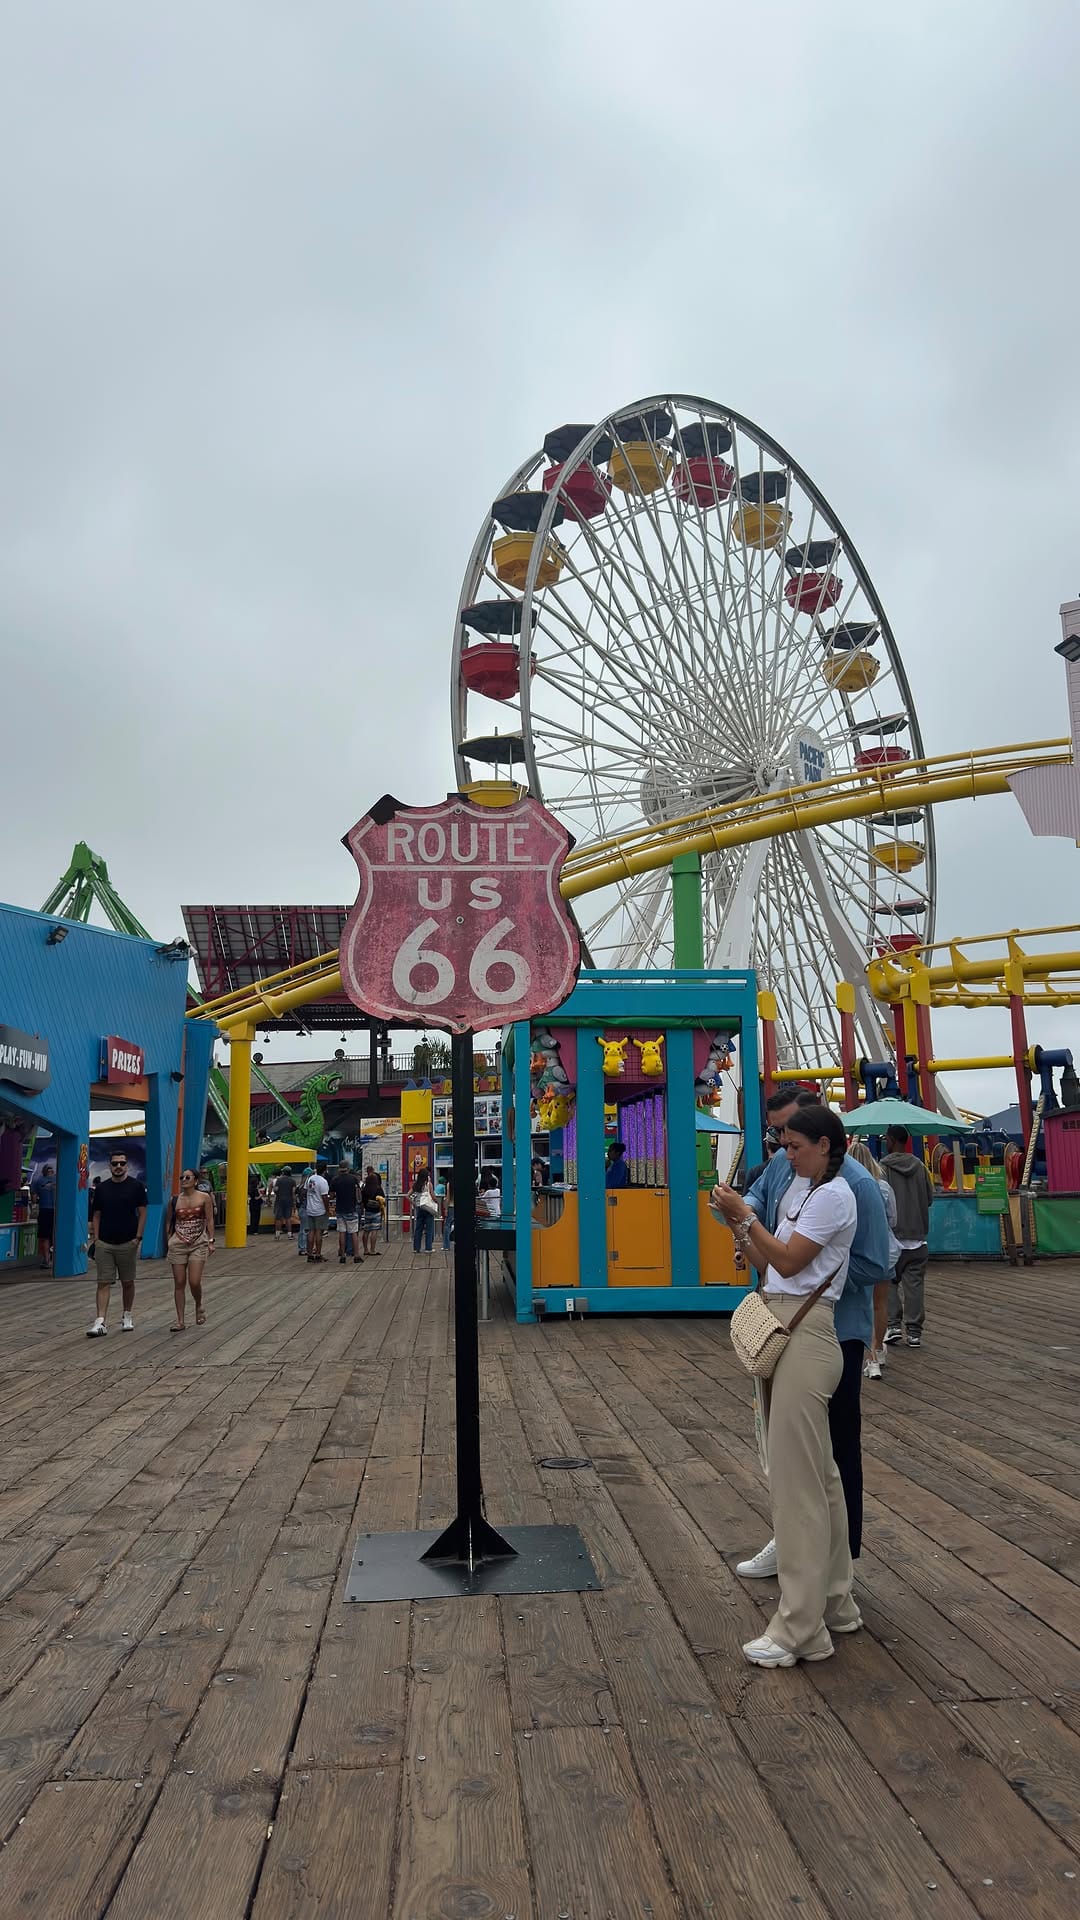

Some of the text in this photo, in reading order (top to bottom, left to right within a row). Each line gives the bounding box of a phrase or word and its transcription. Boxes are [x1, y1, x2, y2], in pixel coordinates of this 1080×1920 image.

[799, 741, 825, 768] PACIFIC
[387, 822, 532, 863] ROUTE
[392, 916, 531, 1006] 66
[111, 1048, 141, 1076] PRIZES
